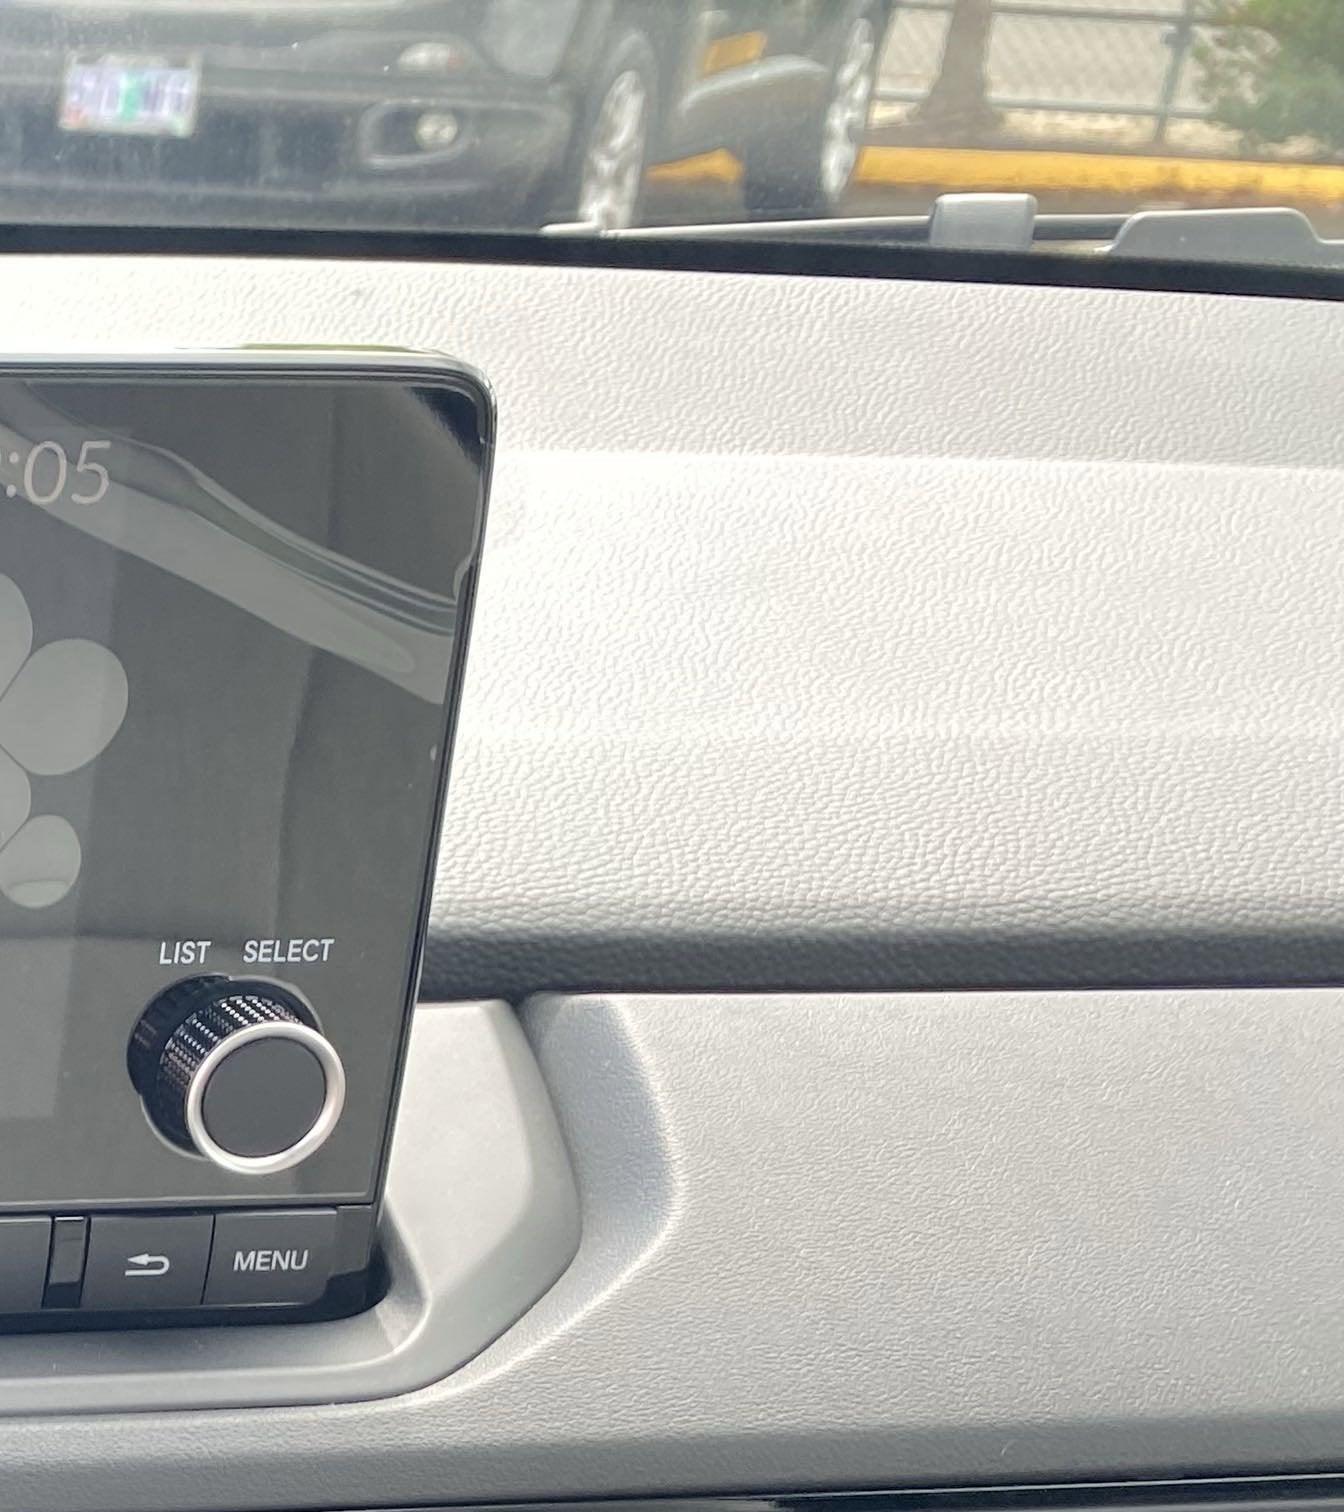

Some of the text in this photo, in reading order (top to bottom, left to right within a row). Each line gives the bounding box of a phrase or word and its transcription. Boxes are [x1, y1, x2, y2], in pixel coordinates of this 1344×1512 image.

[159, 941, 211, 964] LIST
[243, 939, 335, 963] SELECT
[233, 1250, 309, 1273] MENU
